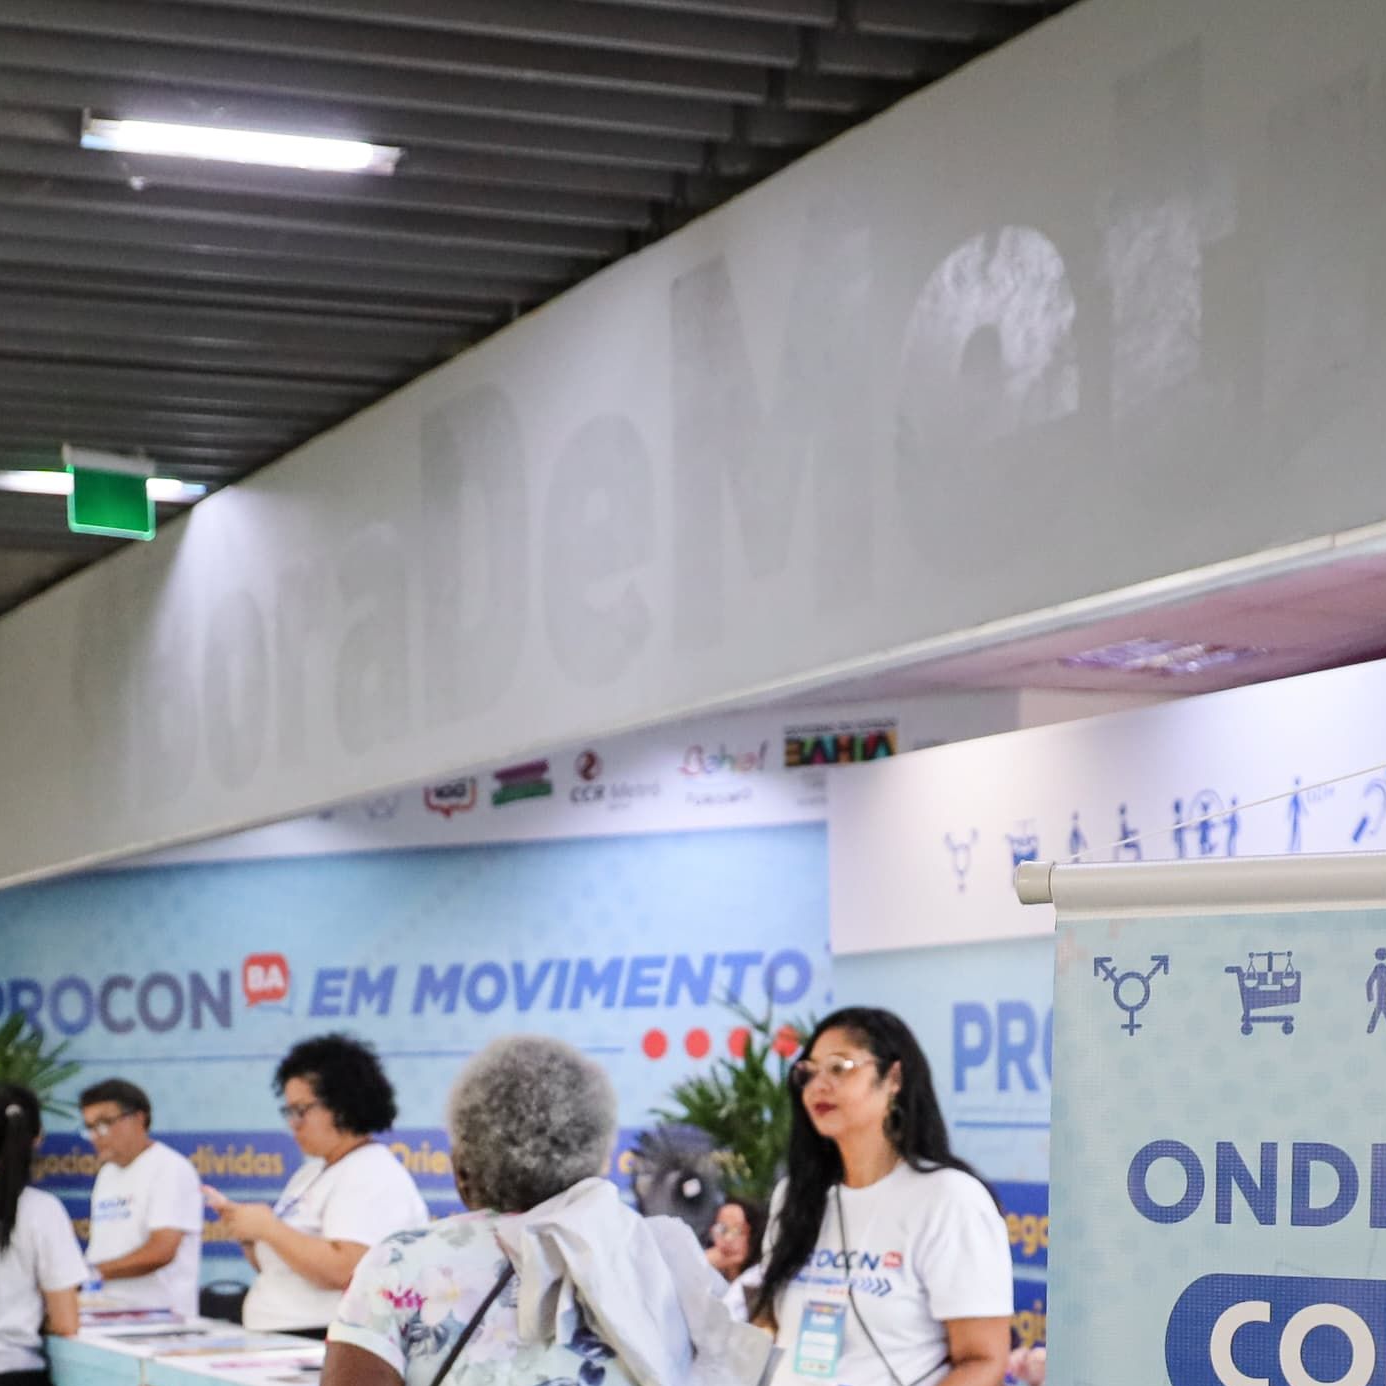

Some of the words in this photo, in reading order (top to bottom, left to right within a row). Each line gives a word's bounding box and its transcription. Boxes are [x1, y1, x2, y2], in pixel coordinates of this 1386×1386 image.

[246, 967, 285, 991] BA
[309, 966, 394, 1017] EM
[413, 948, 813, 1015] MOVIMENTO
[952, 999, 1052, 1092] PR
